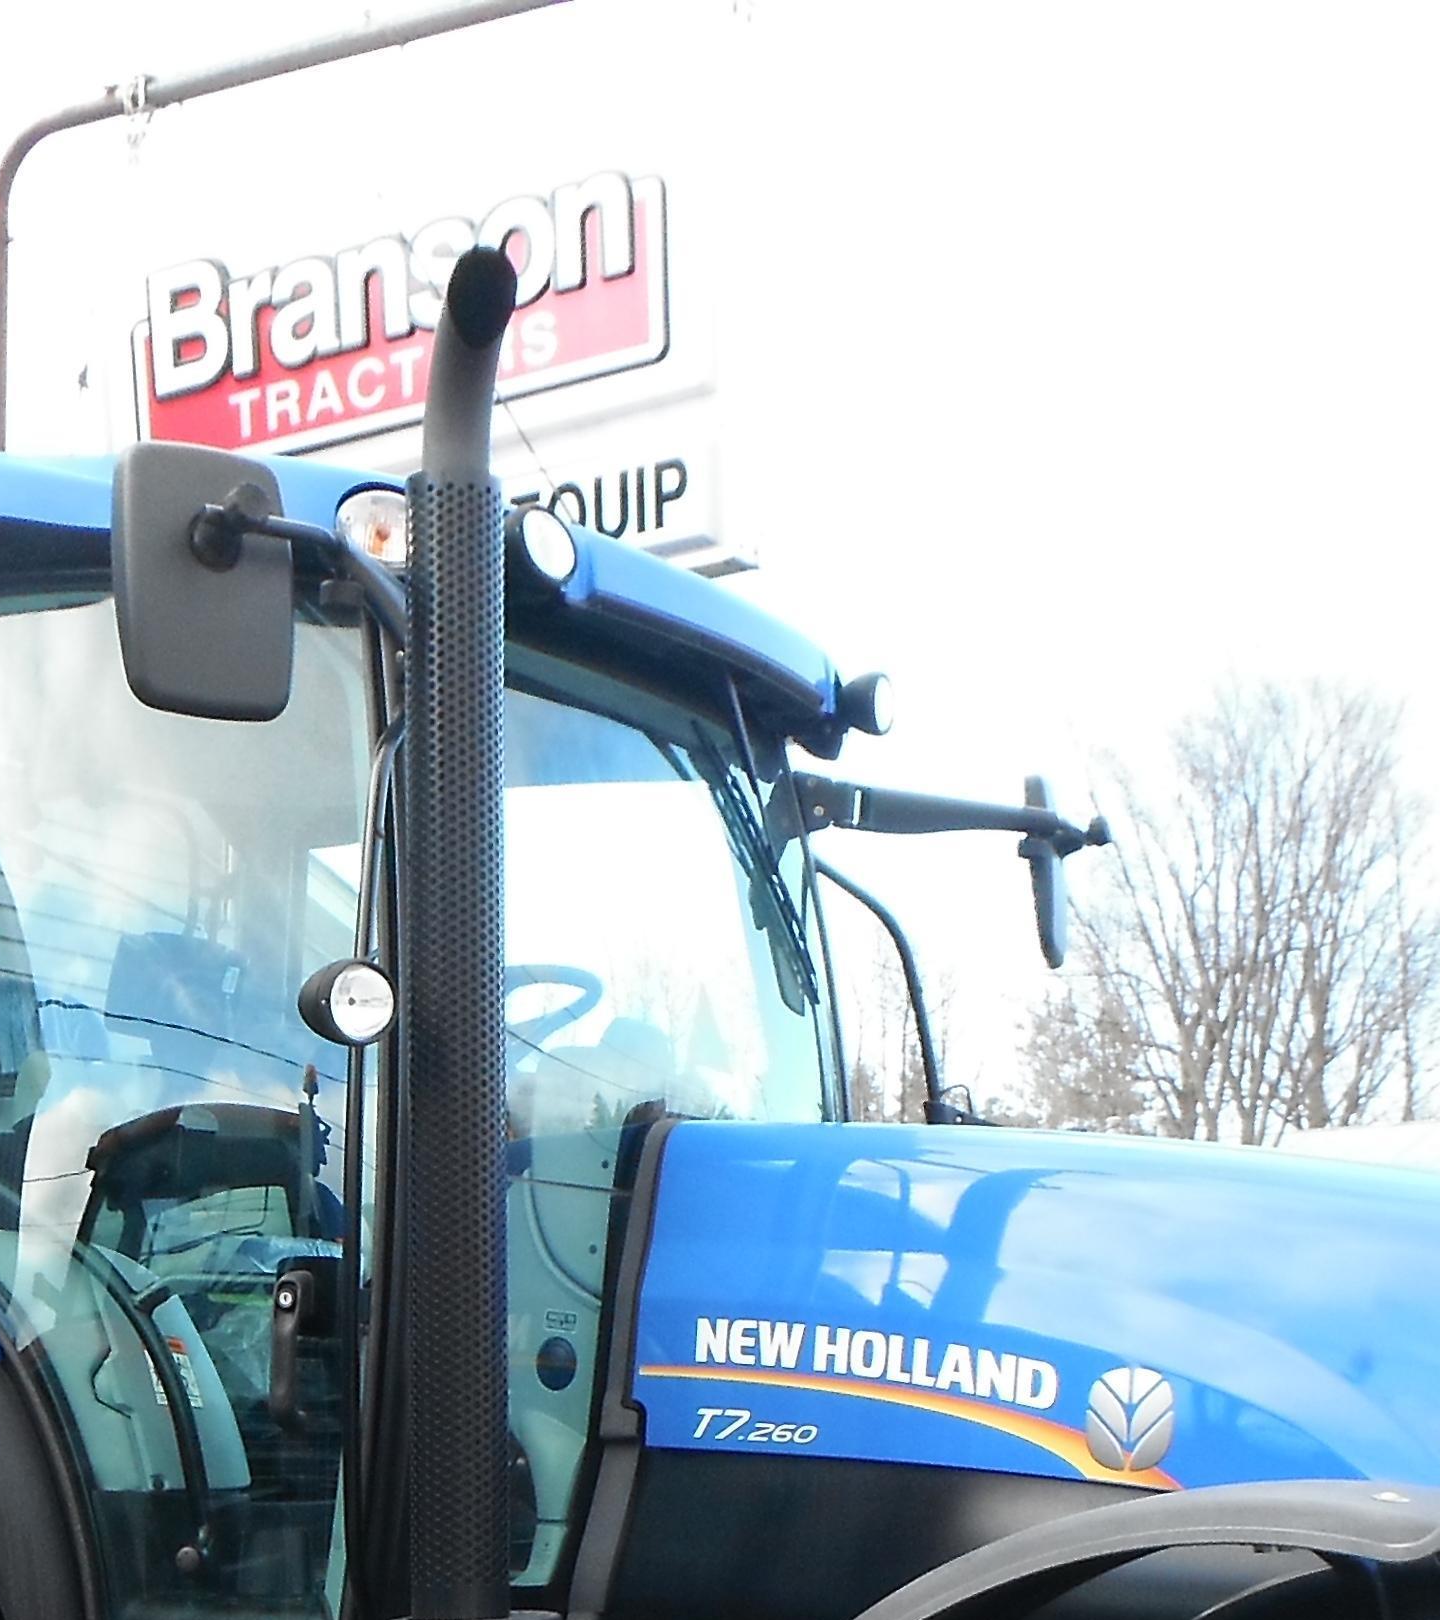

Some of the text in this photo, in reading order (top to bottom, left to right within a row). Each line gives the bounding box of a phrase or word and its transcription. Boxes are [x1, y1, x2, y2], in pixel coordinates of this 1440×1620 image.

[146, 170, 636, 402] Branson
[228, 309, 558, 439] TRACTS
[510, 457, 688, 540] QUIP
[694, 1317, 1059, 1411] NEW HOLLAND
[692, 1407, 819, 1444] T7.260
